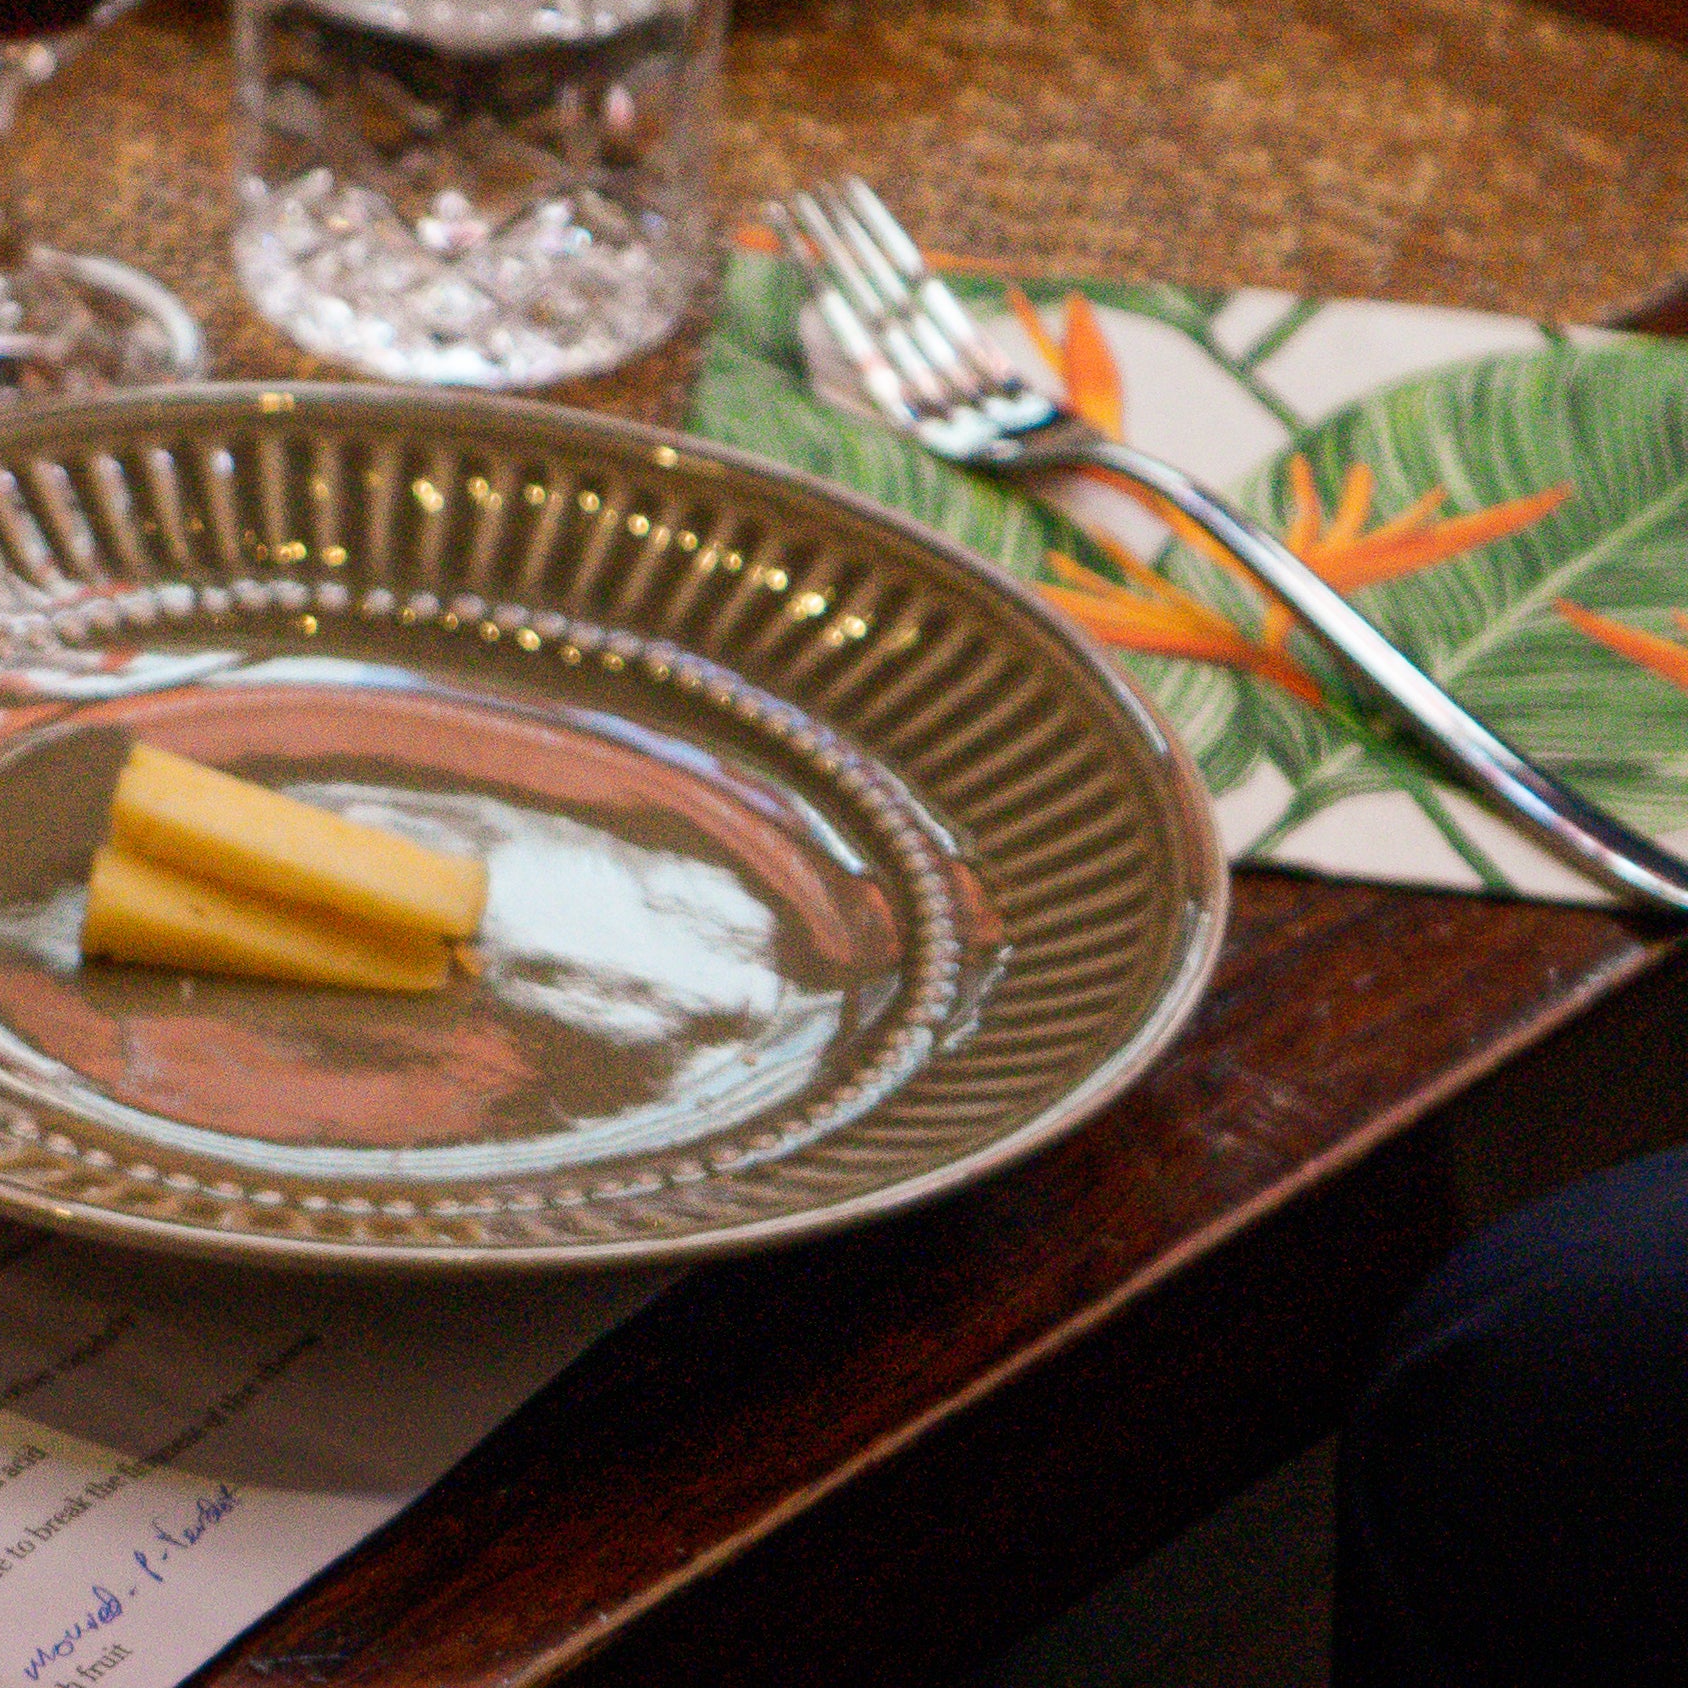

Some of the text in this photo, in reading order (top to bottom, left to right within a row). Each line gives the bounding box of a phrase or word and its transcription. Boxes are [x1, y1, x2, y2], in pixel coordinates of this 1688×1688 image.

[0, 1442, 50, 1481] acid
[3, 1532, 38, 1561] to
[23, 1495, 95, 1543] break
[84, 1473, 126, 1501] the
[74, 1641, 136, 1684] fruit
